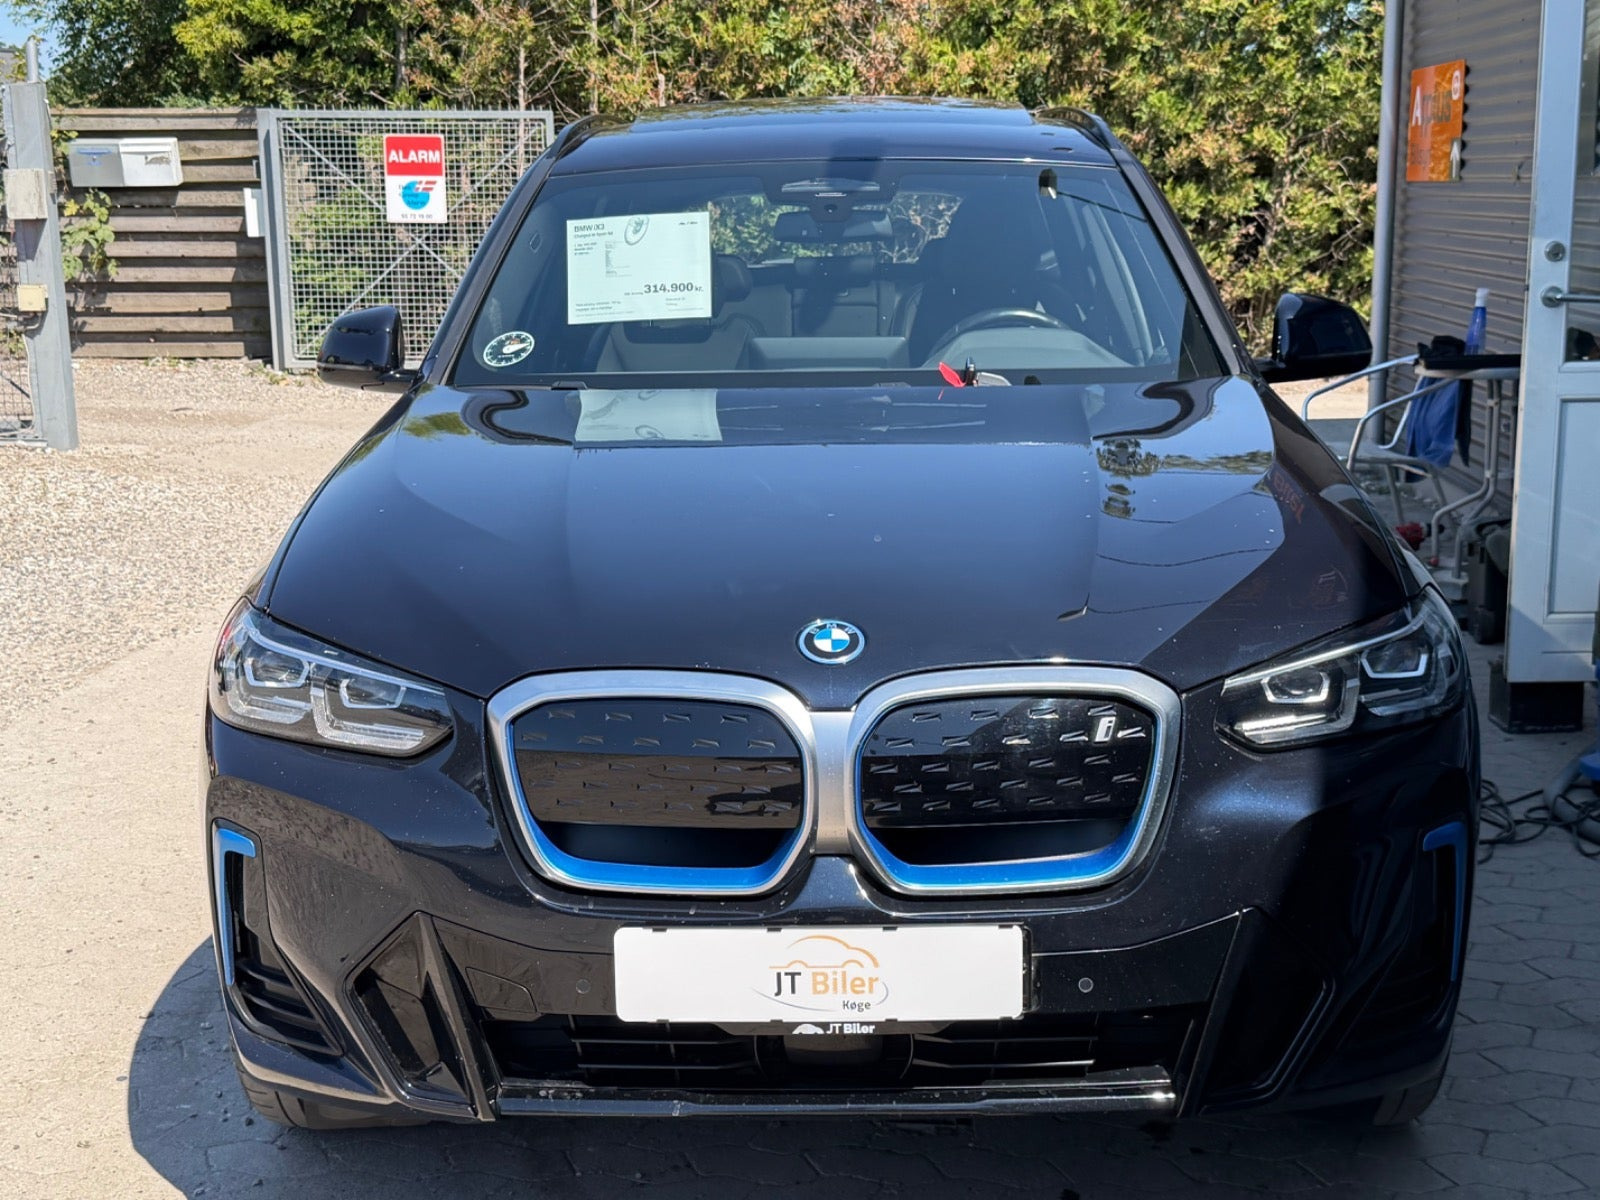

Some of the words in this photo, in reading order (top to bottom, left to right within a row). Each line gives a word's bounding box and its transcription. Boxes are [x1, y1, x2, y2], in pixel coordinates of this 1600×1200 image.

[388, 149, 440, 163] ALARM
[644, 282, 694, 294] 314.900
[774, 972, 801, 996] JT
[811, 971, 879, 995] Biler
[842, 1001, 871, 1013] Køge
[826, 1023, 842, 1034] JT
[843, 1023, 876, 1034] Biler
